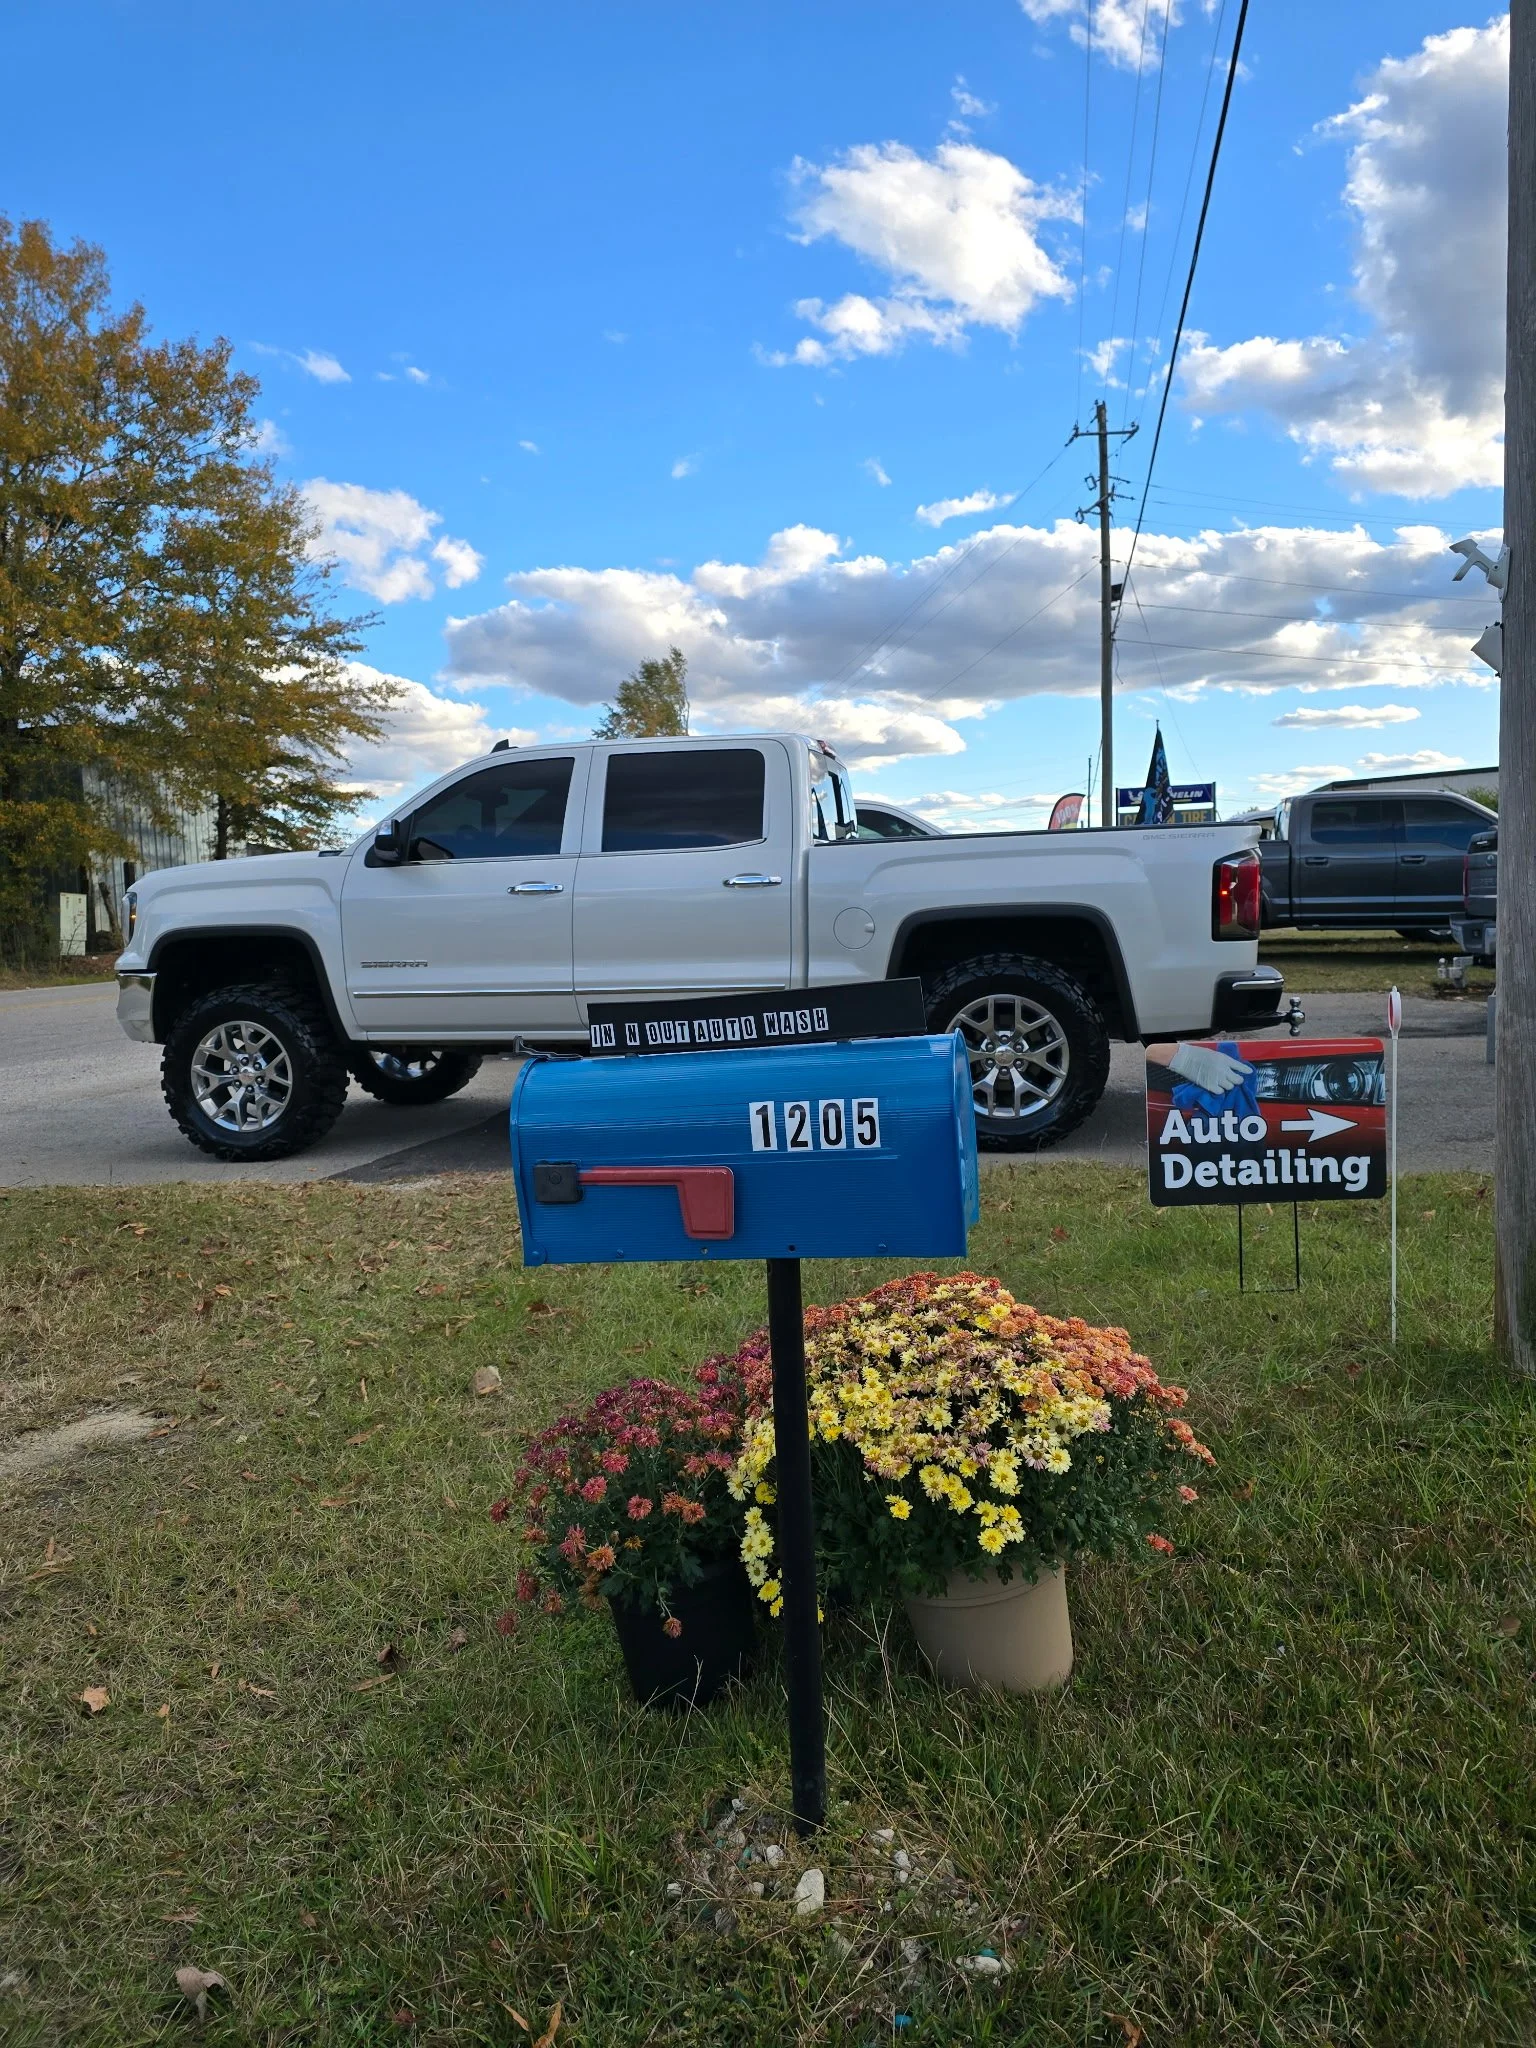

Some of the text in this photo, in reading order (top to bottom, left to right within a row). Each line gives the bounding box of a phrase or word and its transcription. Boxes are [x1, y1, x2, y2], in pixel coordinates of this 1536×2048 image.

[1168, 832, 1216, 840] SIERRA
[360, 960, 428, 969] SIERRA
[592, 1008, 828, 1046] IN N OUT AUTO WASH
[755, 1101, 877, 1149] 1205
[1159, 1108, 1268, 1145] Auto
[1160, 1148, 1371, 1192] Detailing
